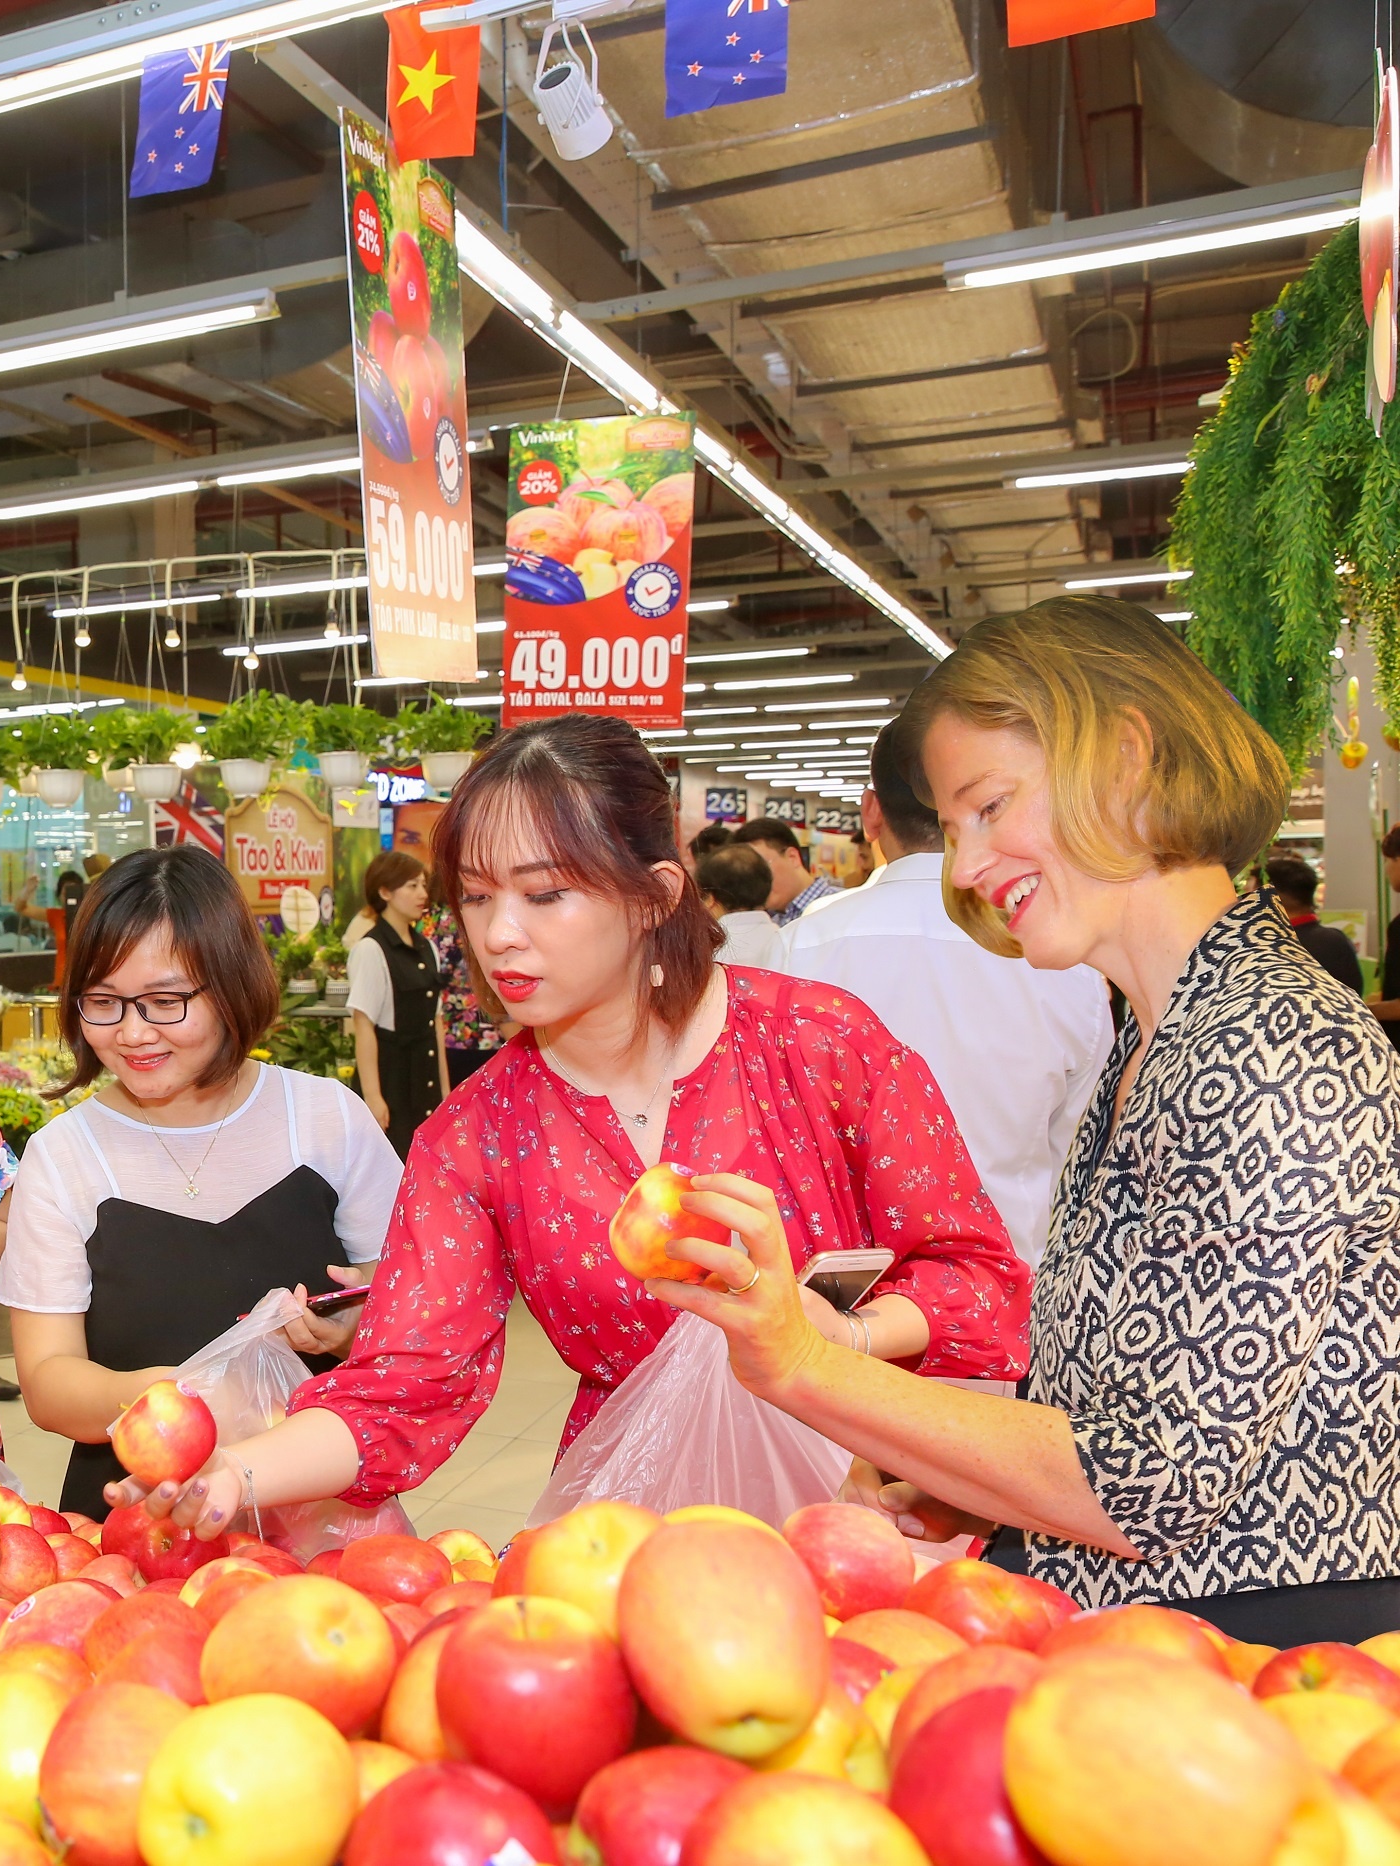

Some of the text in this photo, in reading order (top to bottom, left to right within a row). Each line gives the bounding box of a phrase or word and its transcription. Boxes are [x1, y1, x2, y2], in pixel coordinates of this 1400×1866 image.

[347, 124, 387, 173] VinMart
[357, 224, 380, 256] 21%
[518, 430, 574, 447] VinMart
[520, 480, 558, 496] 20%
[535, 692, 572, 707] ROYAL
[817, 811, 841, 828] 22
[236, 837, 325, 872] Táo & Kiwi
